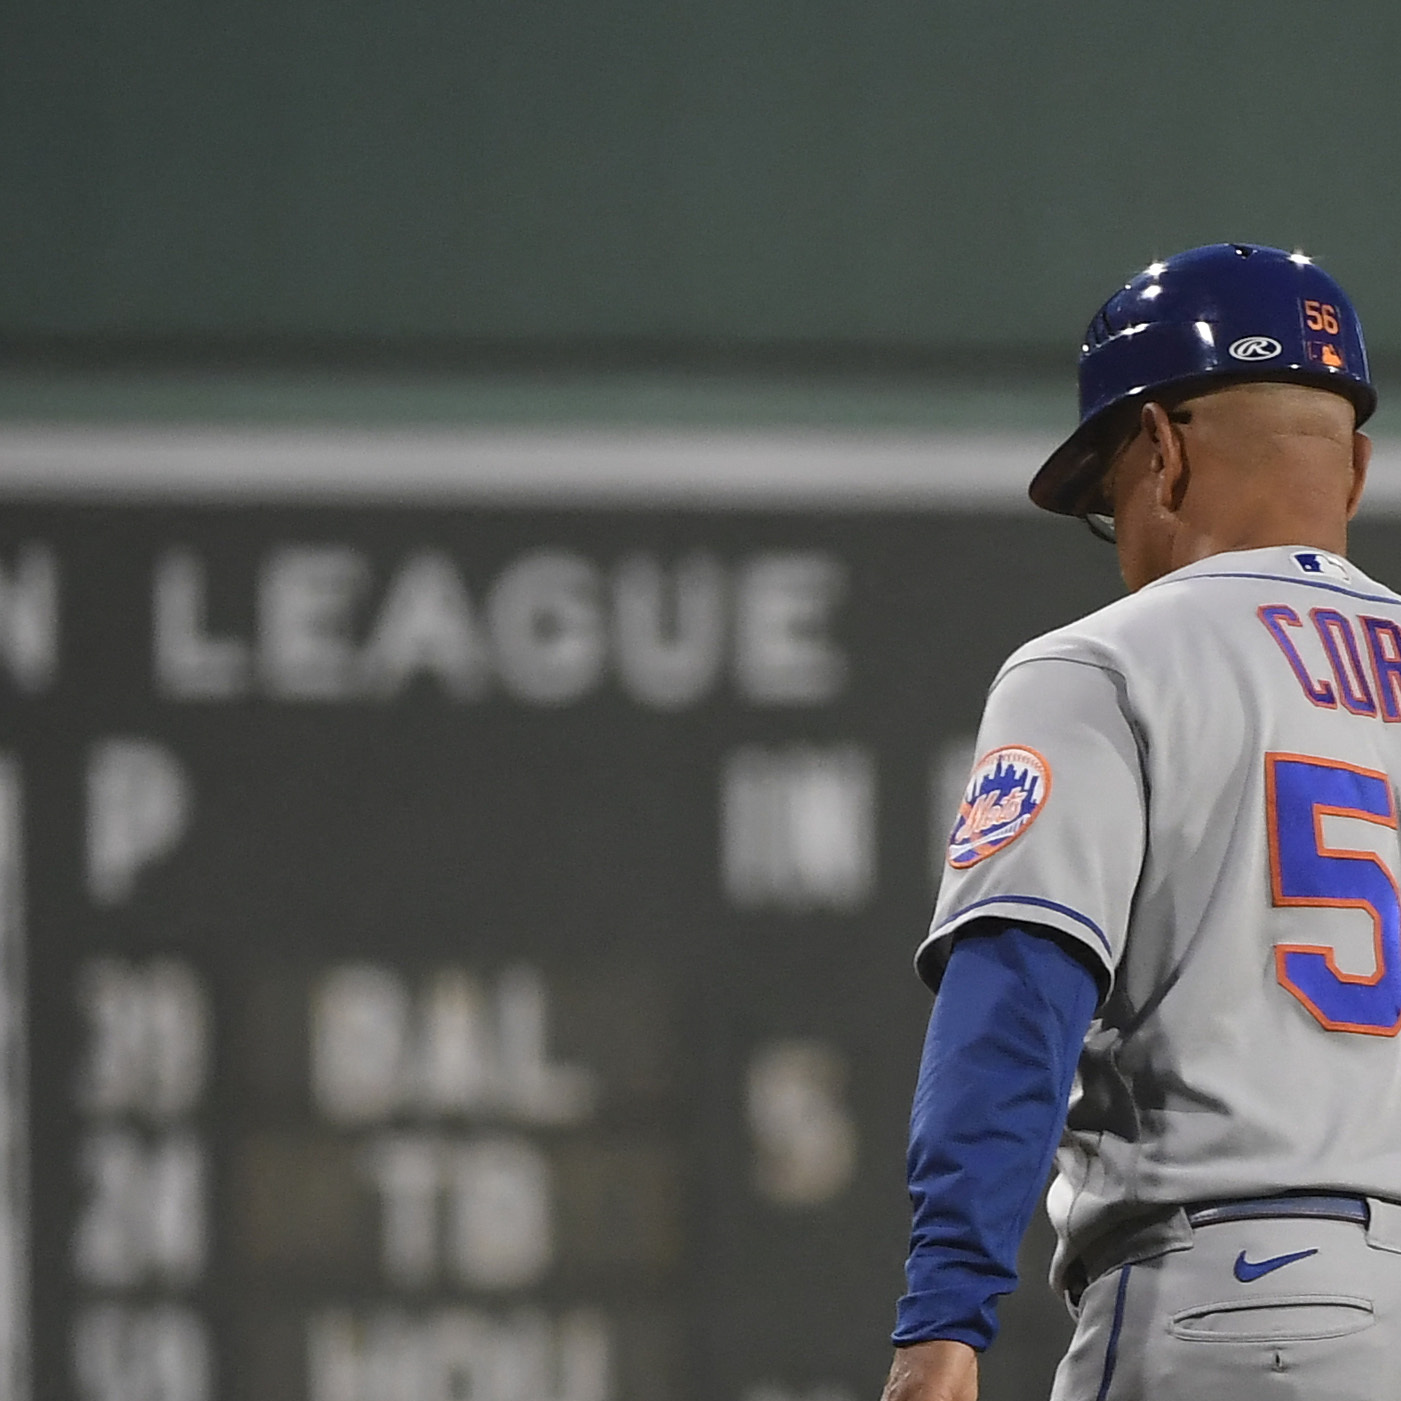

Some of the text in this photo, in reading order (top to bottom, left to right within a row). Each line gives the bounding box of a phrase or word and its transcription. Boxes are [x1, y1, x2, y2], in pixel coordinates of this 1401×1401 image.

[1304, 300, 1340, 335] 56
[152, 547, 846, 706] LEAGUE
[86, 740, 190, 902] P
[312, 967, 595, 1124] BAL
[367, 1134, 554, 1289] TB
